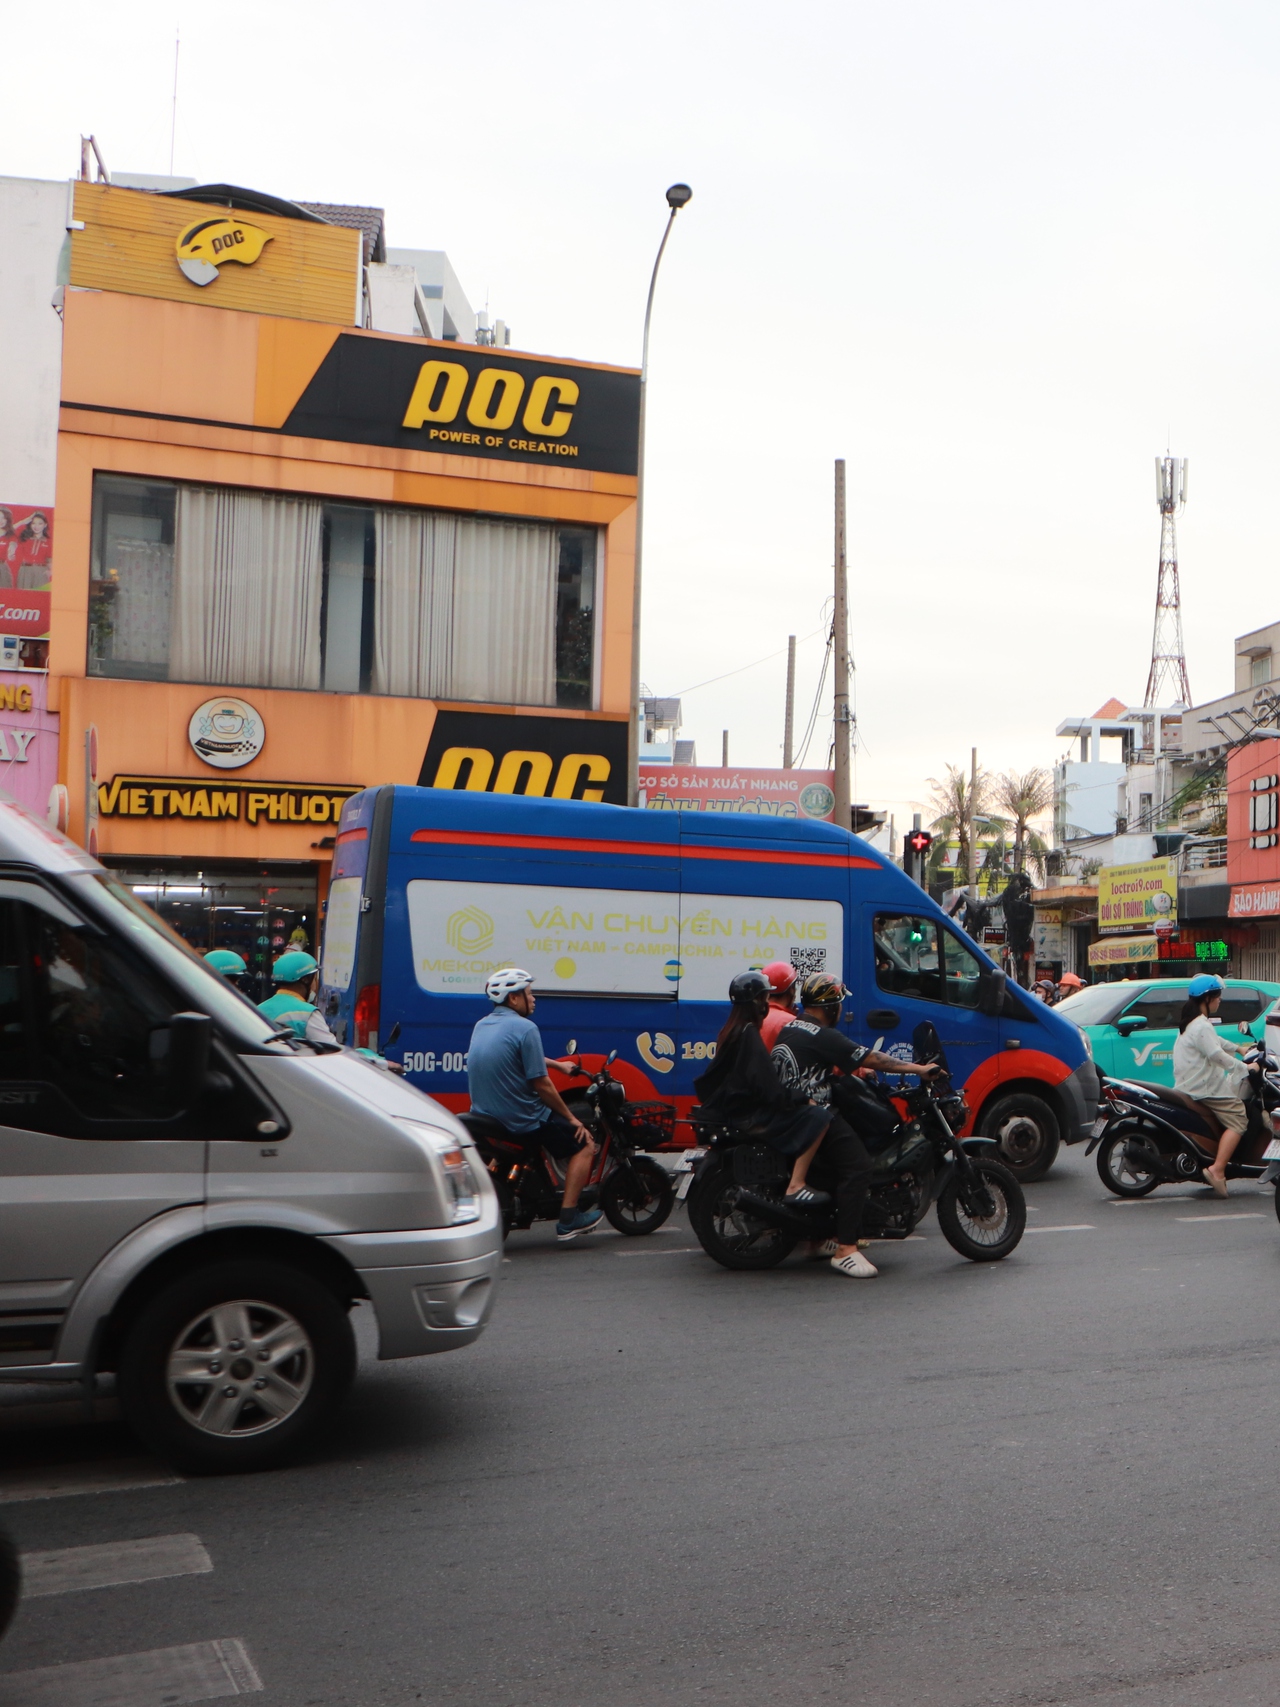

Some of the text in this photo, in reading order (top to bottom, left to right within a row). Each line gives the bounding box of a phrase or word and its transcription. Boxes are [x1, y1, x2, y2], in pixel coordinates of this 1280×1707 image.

[429, 428, 579, 457] POWER OF CREATION
[98, 776, 238, 817] VIETNAM
[660, 774, 679, 788] SỞ
[682, 775, 708, 788] SẢN
[712, 774, 747, 789] XUẤT
[751, 780, 798, 791] NHANG
[526, 905, 827, 941] VẬN CHUYỂN HÀNG
[525, 936, 775, 959] VIỆT NAM CAMPUCHIA LÀO
